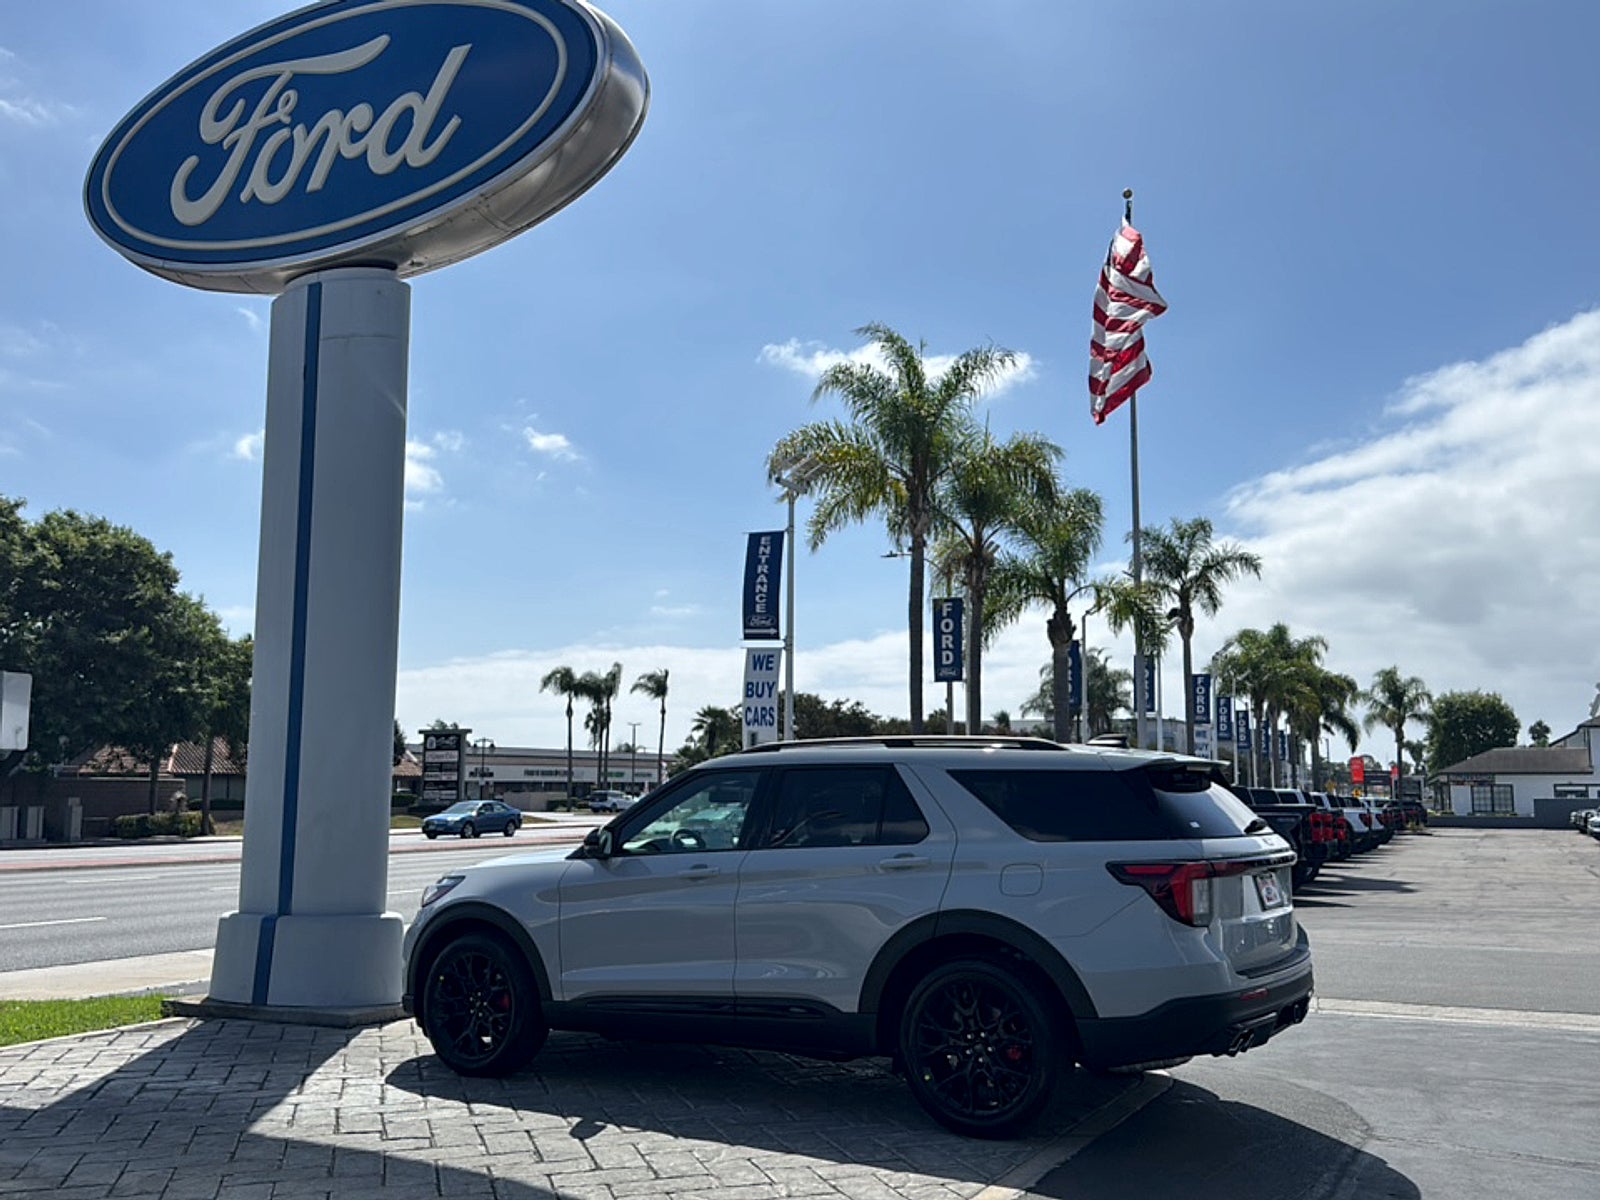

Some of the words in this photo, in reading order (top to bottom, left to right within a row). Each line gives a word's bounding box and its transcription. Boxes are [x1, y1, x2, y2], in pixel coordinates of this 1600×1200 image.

[170, 33, 473, 227] Ford
[754, 535, 772, 614] ENTRANCE
[940, 601, 955, 666] FORD
[752, 653, 775, 672] WE
[745, 680, 776, 699] BUY
[1196, 676, 1206, 714] FORD
[744, 706, 775, 727] CARS
[1218, 699, 1228, 732] FORD
